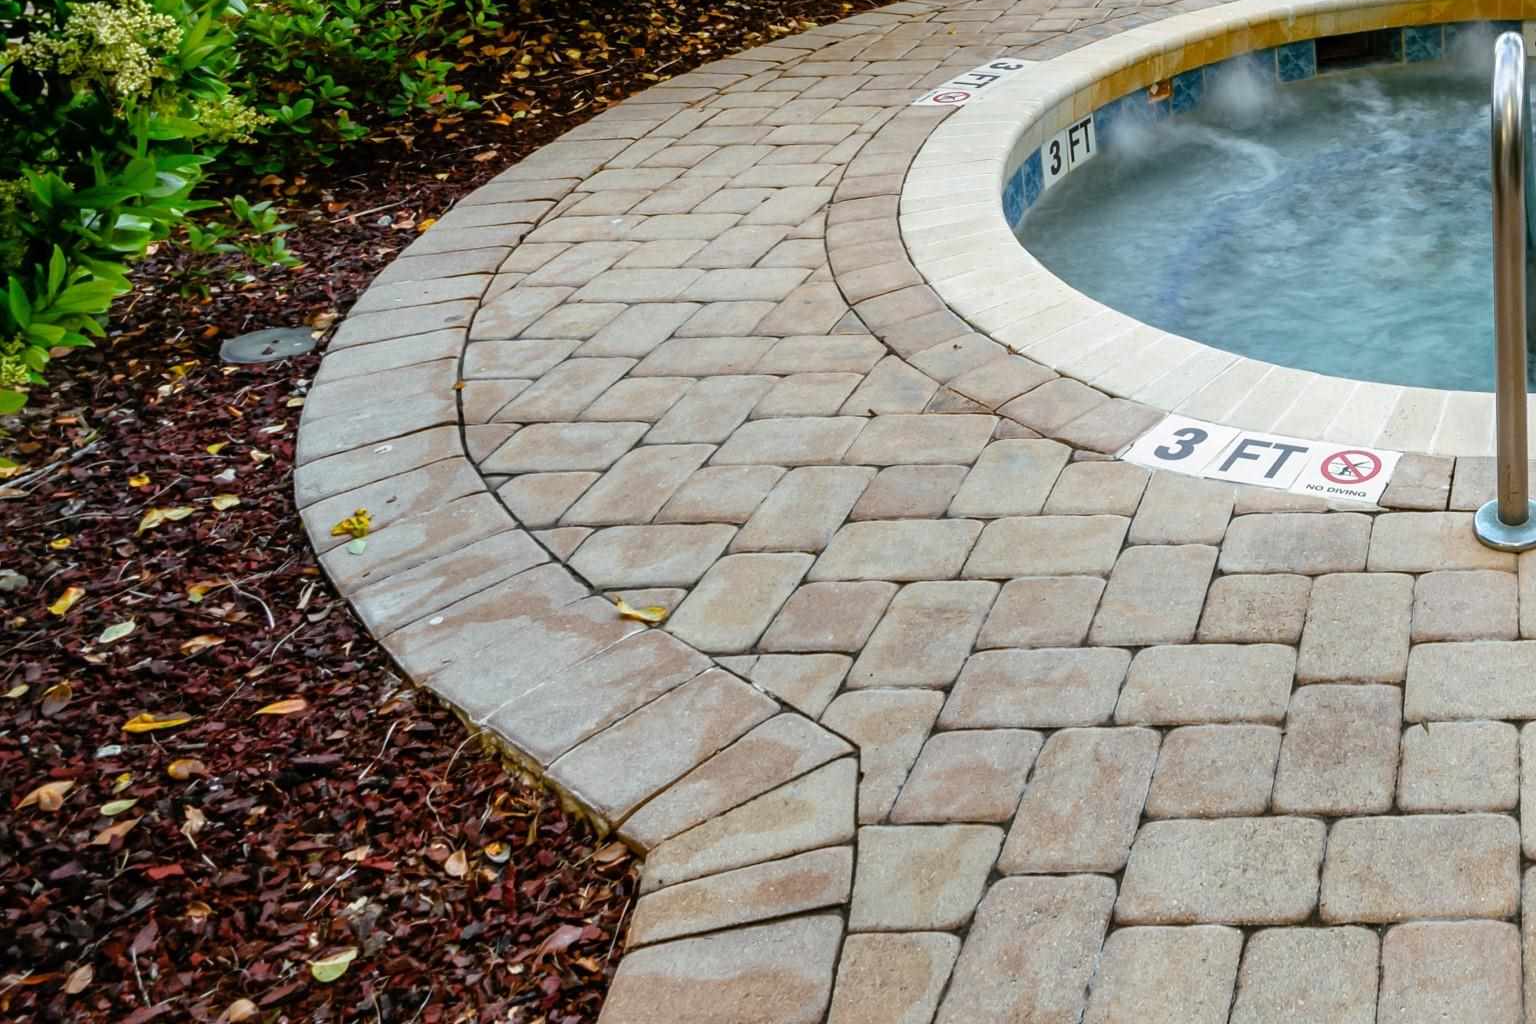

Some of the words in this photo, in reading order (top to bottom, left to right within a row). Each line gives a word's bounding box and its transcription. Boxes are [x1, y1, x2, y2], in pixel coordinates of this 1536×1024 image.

[989, 62, 1024, 71] 3
[953, 73, 1000, 88] FT
[1050, 139, 1062, 176] 3
[1068, 118, 1092, 162] FT
[1153, 427, 1209, 461] 3
[1218, 438, 1309, 479] FT
[1306, 483, 1324, 491] NO
[1327, 487, 1367, 497] DIVING
